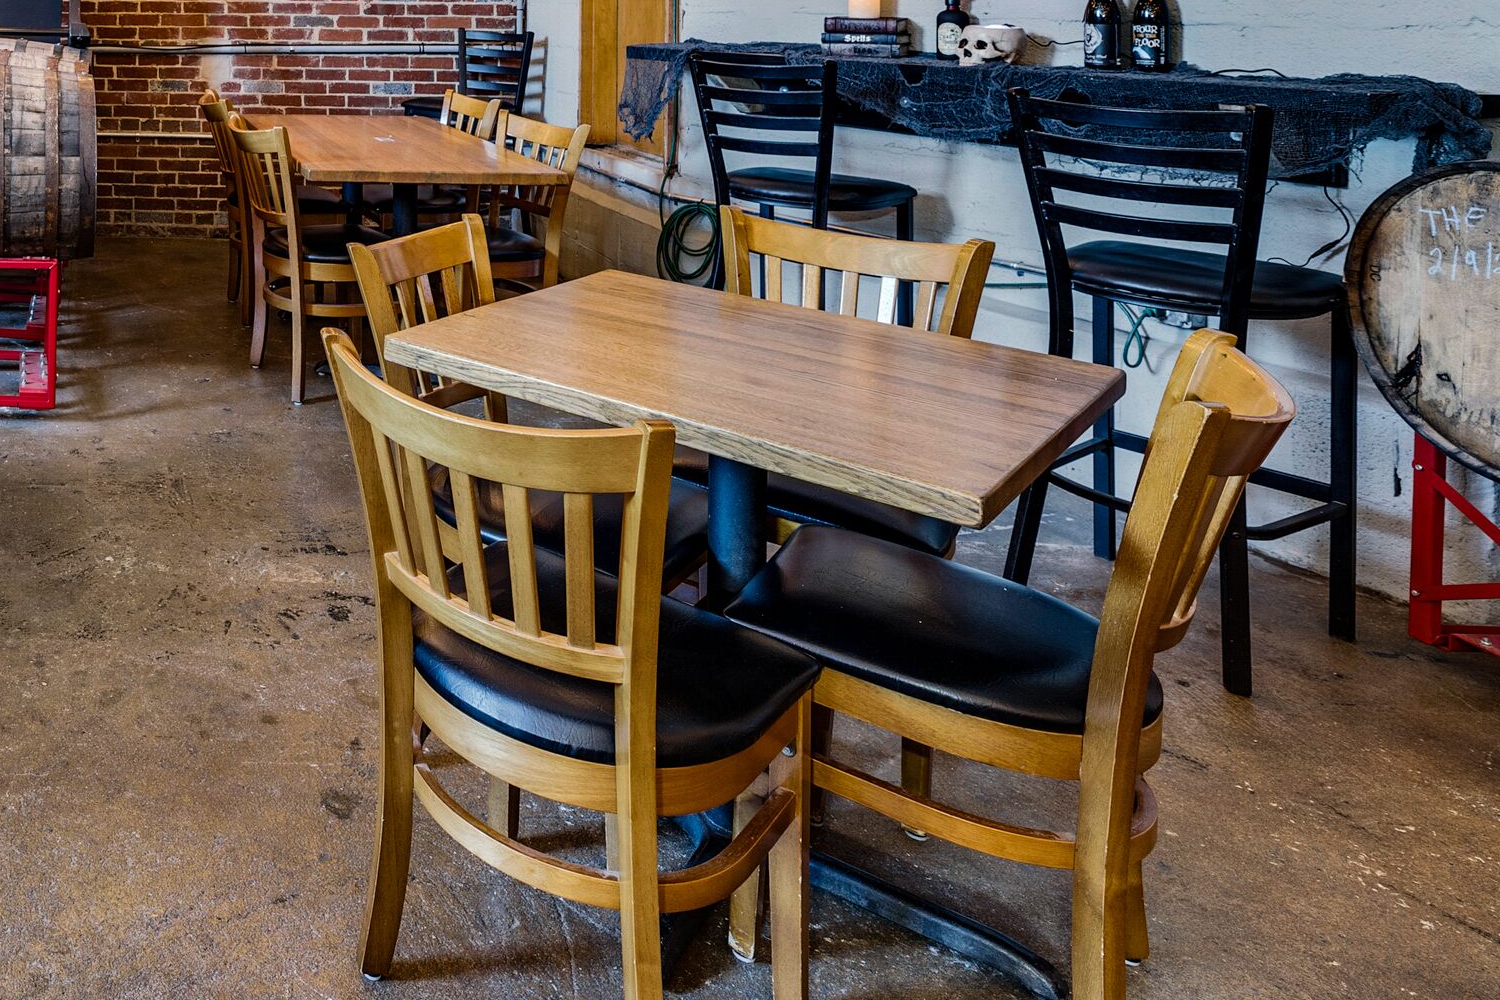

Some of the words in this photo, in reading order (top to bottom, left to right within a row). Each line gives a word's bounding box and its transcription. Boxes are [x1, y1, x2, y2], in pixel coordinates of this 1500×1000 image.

[1134, 24, 1158, 34] FOUR
[844, 34, 871, 43] Spells
[1134, 38, 1160, 48] FLOOR
[1419, 205, 1488, 237] THE
